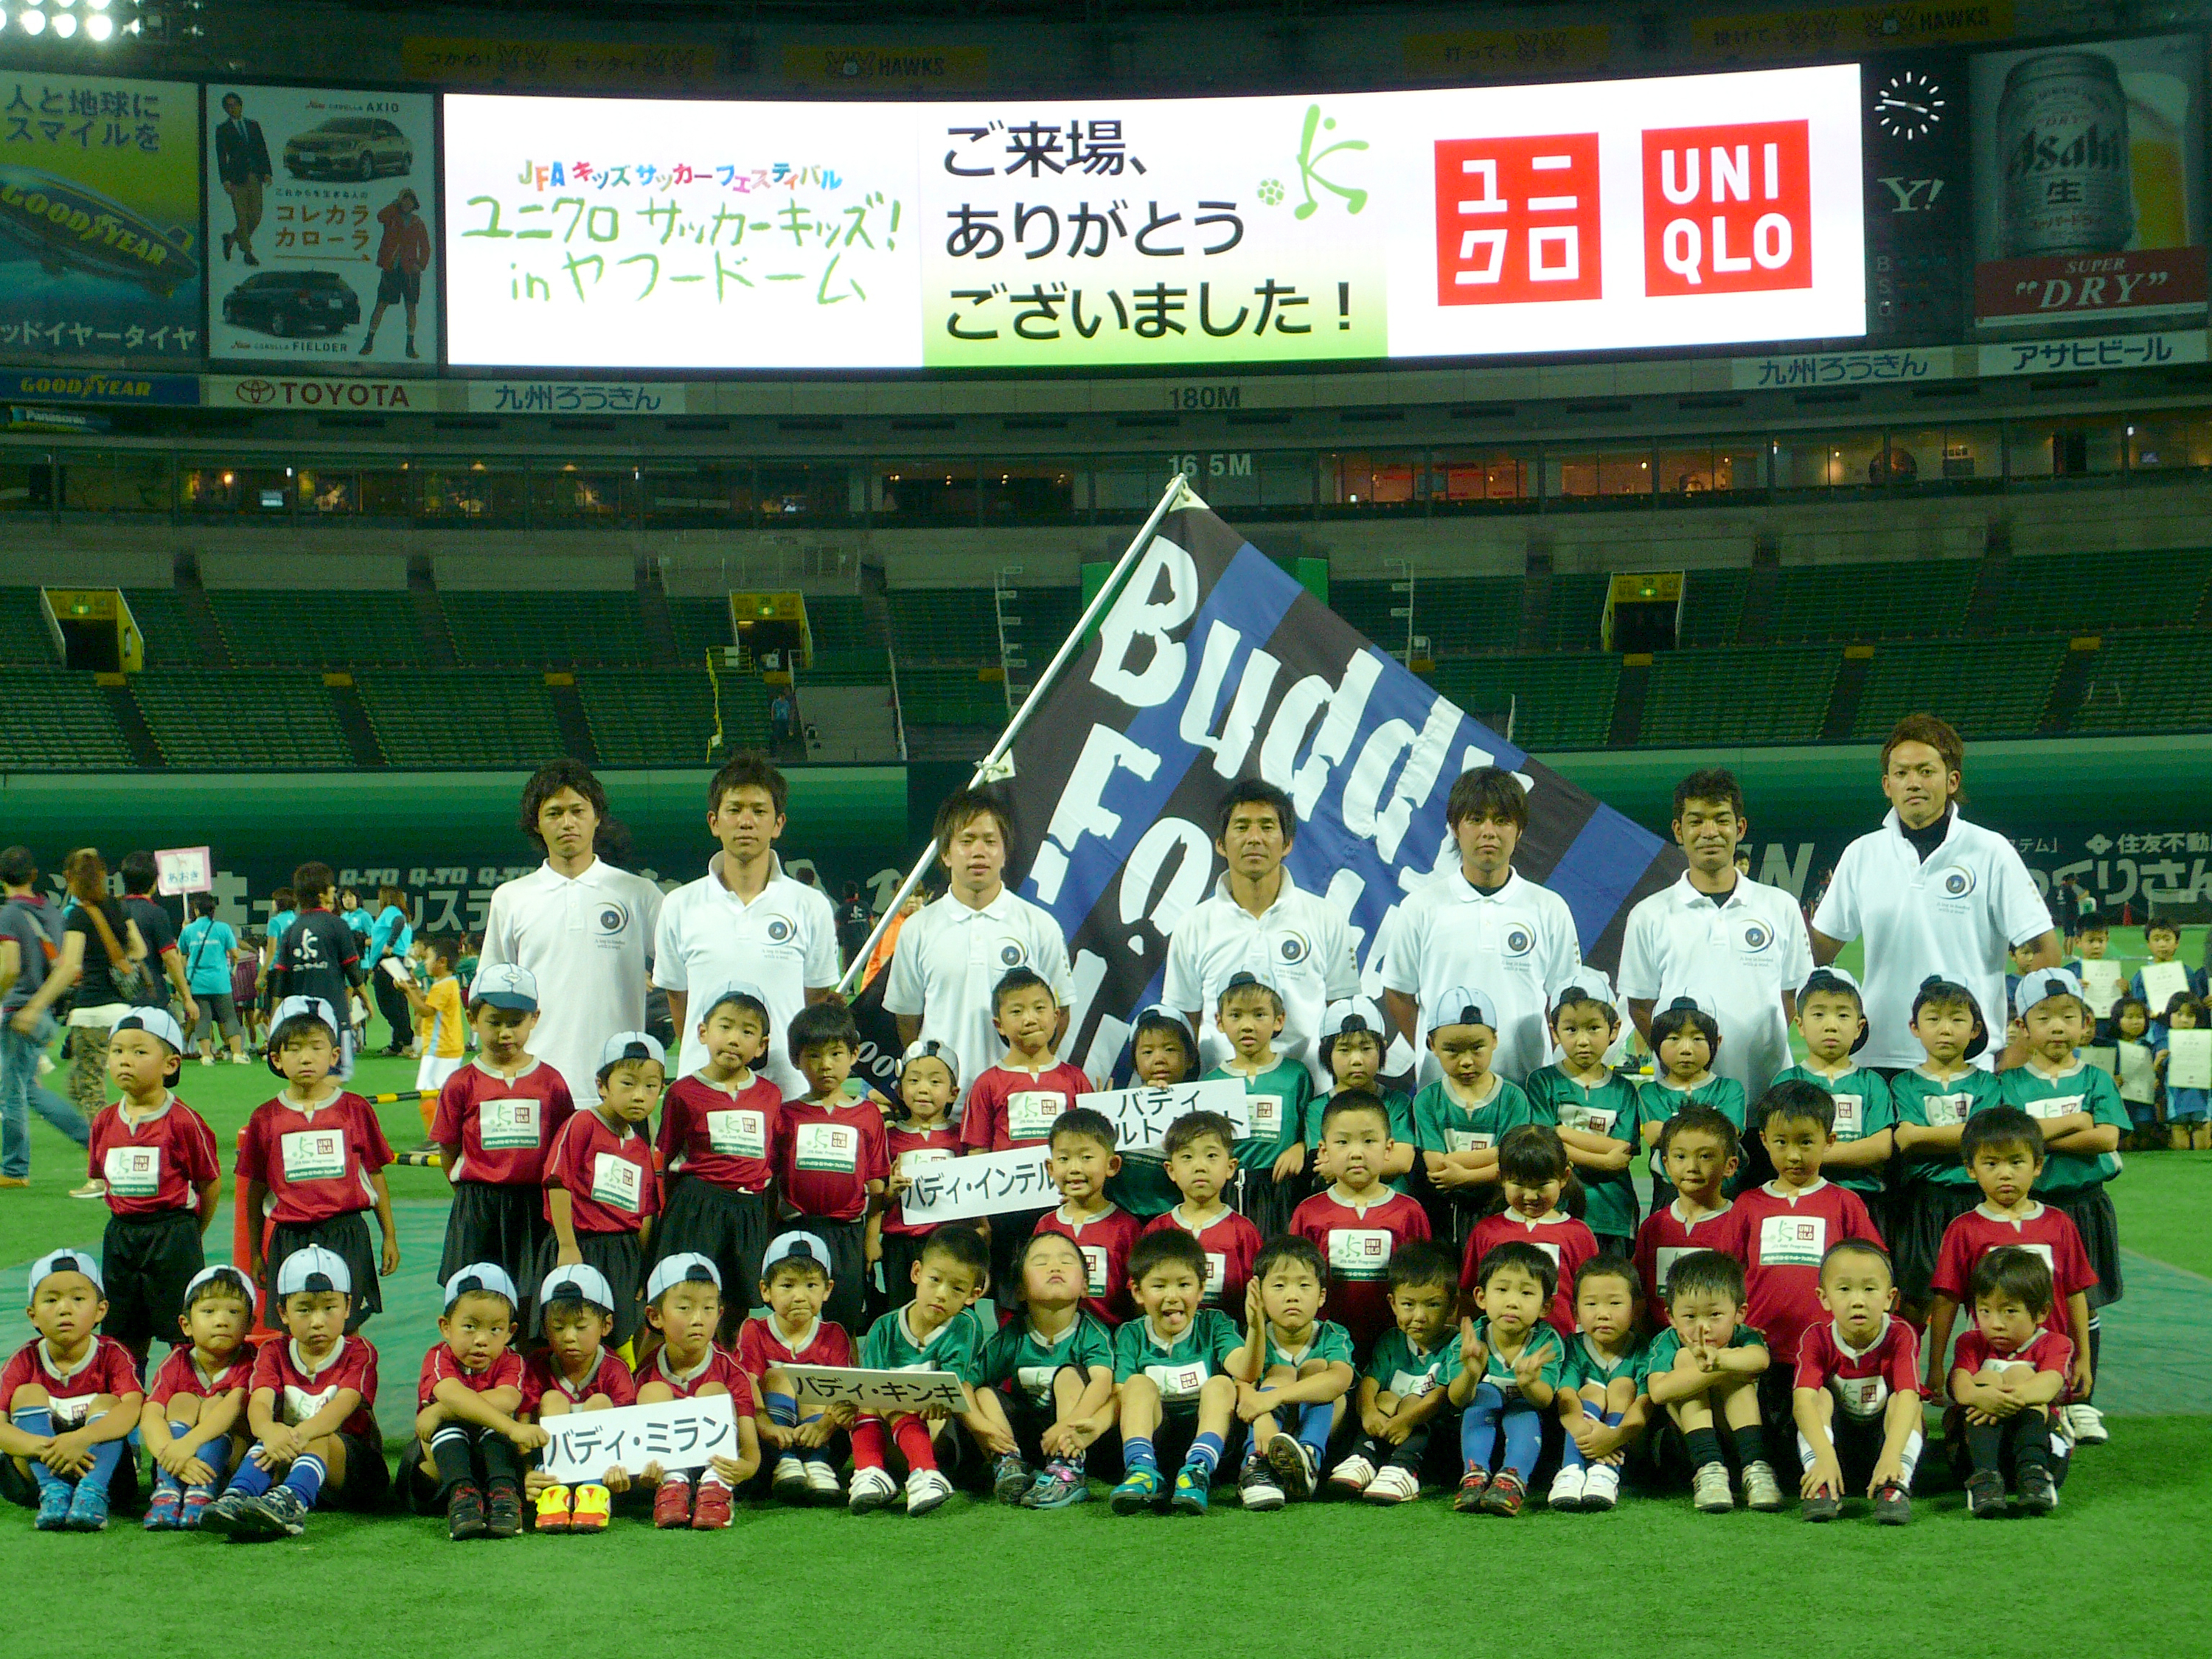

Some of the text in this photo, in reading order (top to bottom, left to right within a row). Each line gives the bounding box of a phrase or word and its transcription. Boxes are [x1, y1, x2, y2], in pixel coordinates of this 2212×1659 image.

[5, 84, 161, 120] 人と地球に
[366, 102, 400, 113] AXIO
[5, 116, 160, 153] スマイルを
[944, 119, 1147, 178] ご来場、
[518, 159, 566, 192] JFA
[1660, 142, 1778, 205] UNI
[1877, 176, 1945, 213] Y!
[2047, 178, 2083, 205] 生
[276, 204, 369, 226] コレカラ
[945, 199, 1245, 260] ありがとう
[275, 226, 369, 251] カローラ
[1662, 212, 1793, 285] QLO
[2067, 257, 2126, 274] SUPER
[510, 262, 551, 302] in
[292, 341, 347, 354] FIELDER
[2011, 335, 2174, 372] アサヒビール
[1758, 351, 1928, 386] 九州ろうきん
[20, 374, 151, 398] GOODYEAR
[279, 382, 409, 406] TOYOTA
[495, 384, 661, 411] 九州ろうきん
[1169, 386, 1242, 408] 180M
[2117, 832, 2212, 854] 住友不動
[1118, 1087, 1200, 1119] バディ
[795, 1376, 962, 1405] バディ・キンキ
[546, 1414, 730, 1470] バディ・ミラン
